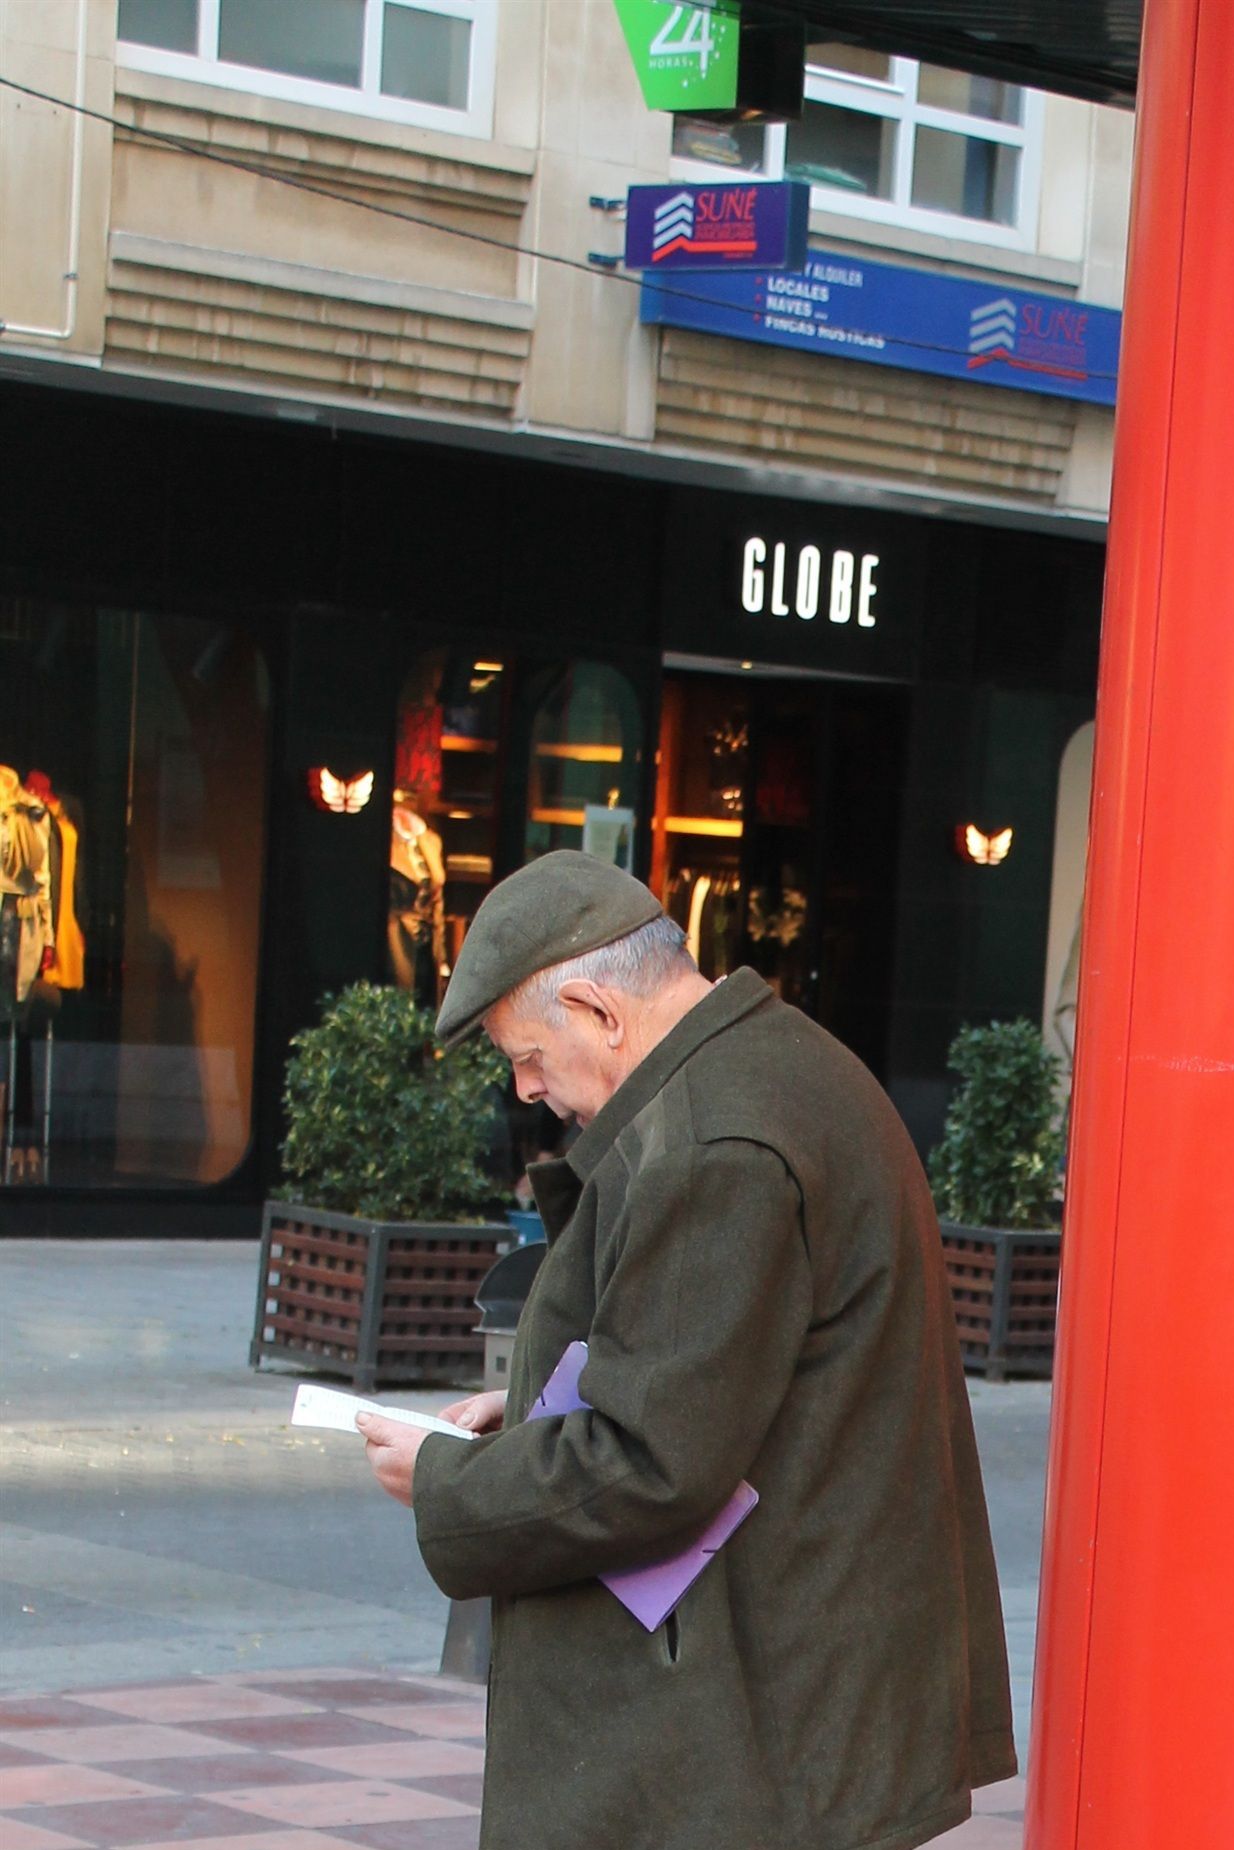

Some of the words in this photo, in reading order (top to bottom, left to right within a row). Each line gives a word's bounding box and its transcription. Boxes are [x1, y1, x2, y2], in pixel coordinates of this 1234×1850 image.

[650, 0, 714, 76] 24
[766, 294, 813, 318] NAVES
[767, 276, 830, 302] LOCALES
[742, 537, 880, 628] GLOBE
